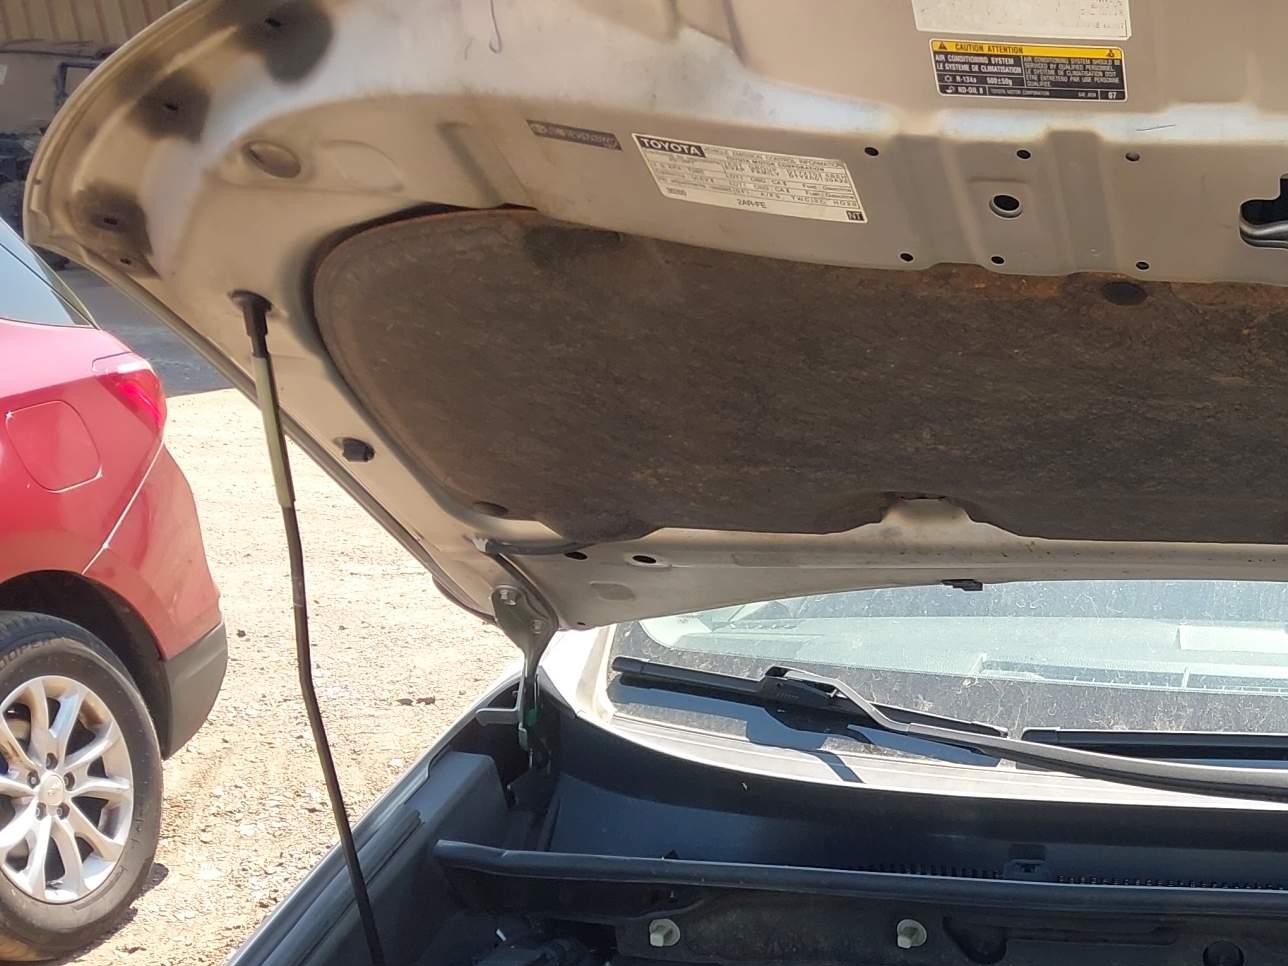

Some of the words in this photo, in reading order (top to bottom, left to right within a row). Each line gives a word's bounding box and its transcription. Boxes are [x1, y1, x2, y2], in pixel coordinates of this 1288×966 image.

[955, 44, 984, 52] CAUTION
[988, 45, 1024, 54] ATTENTION
[640, 138, 702, 156] TOYOTA
